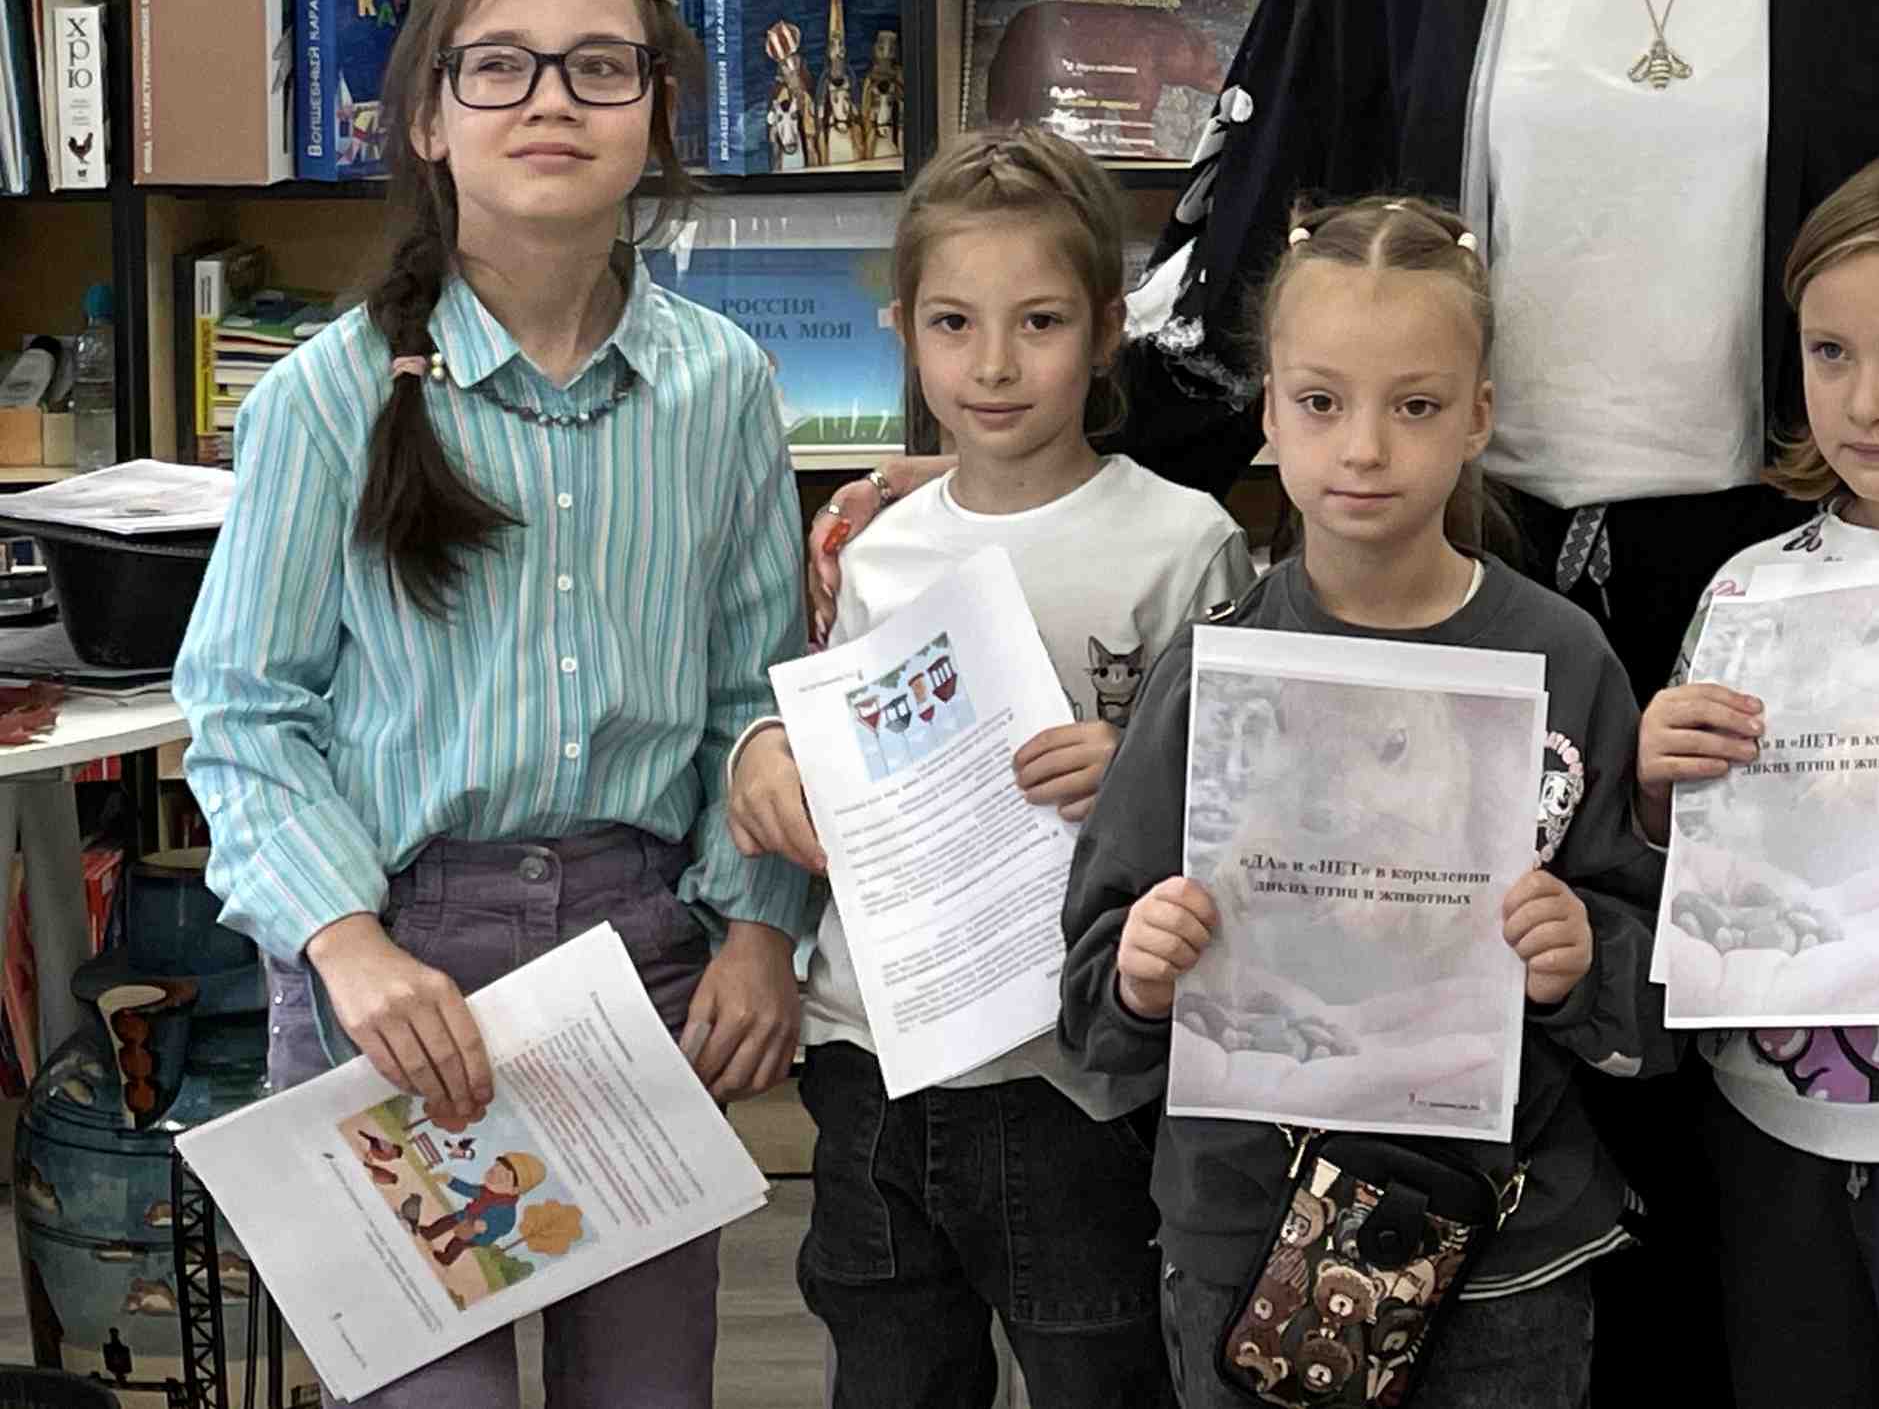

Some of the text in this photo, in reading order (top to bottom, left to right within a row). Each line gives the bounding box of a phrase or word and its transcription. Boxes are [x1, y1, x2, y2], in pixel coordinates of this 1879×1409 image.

[720, 297, 817, 316] РОССИЯ
[799, 322, 852, 339] МОЯ
[1239, 853, 1288, 872] «ДА»
[1308, 859, 1371, 877] «НЕТ»
[1390, 868, 1492, 885] кормлении
[1253, 880, 1310, 895] диких
[1314, 884, 1358, 900] птиц
[1378, 890, 1472, 906] животных
